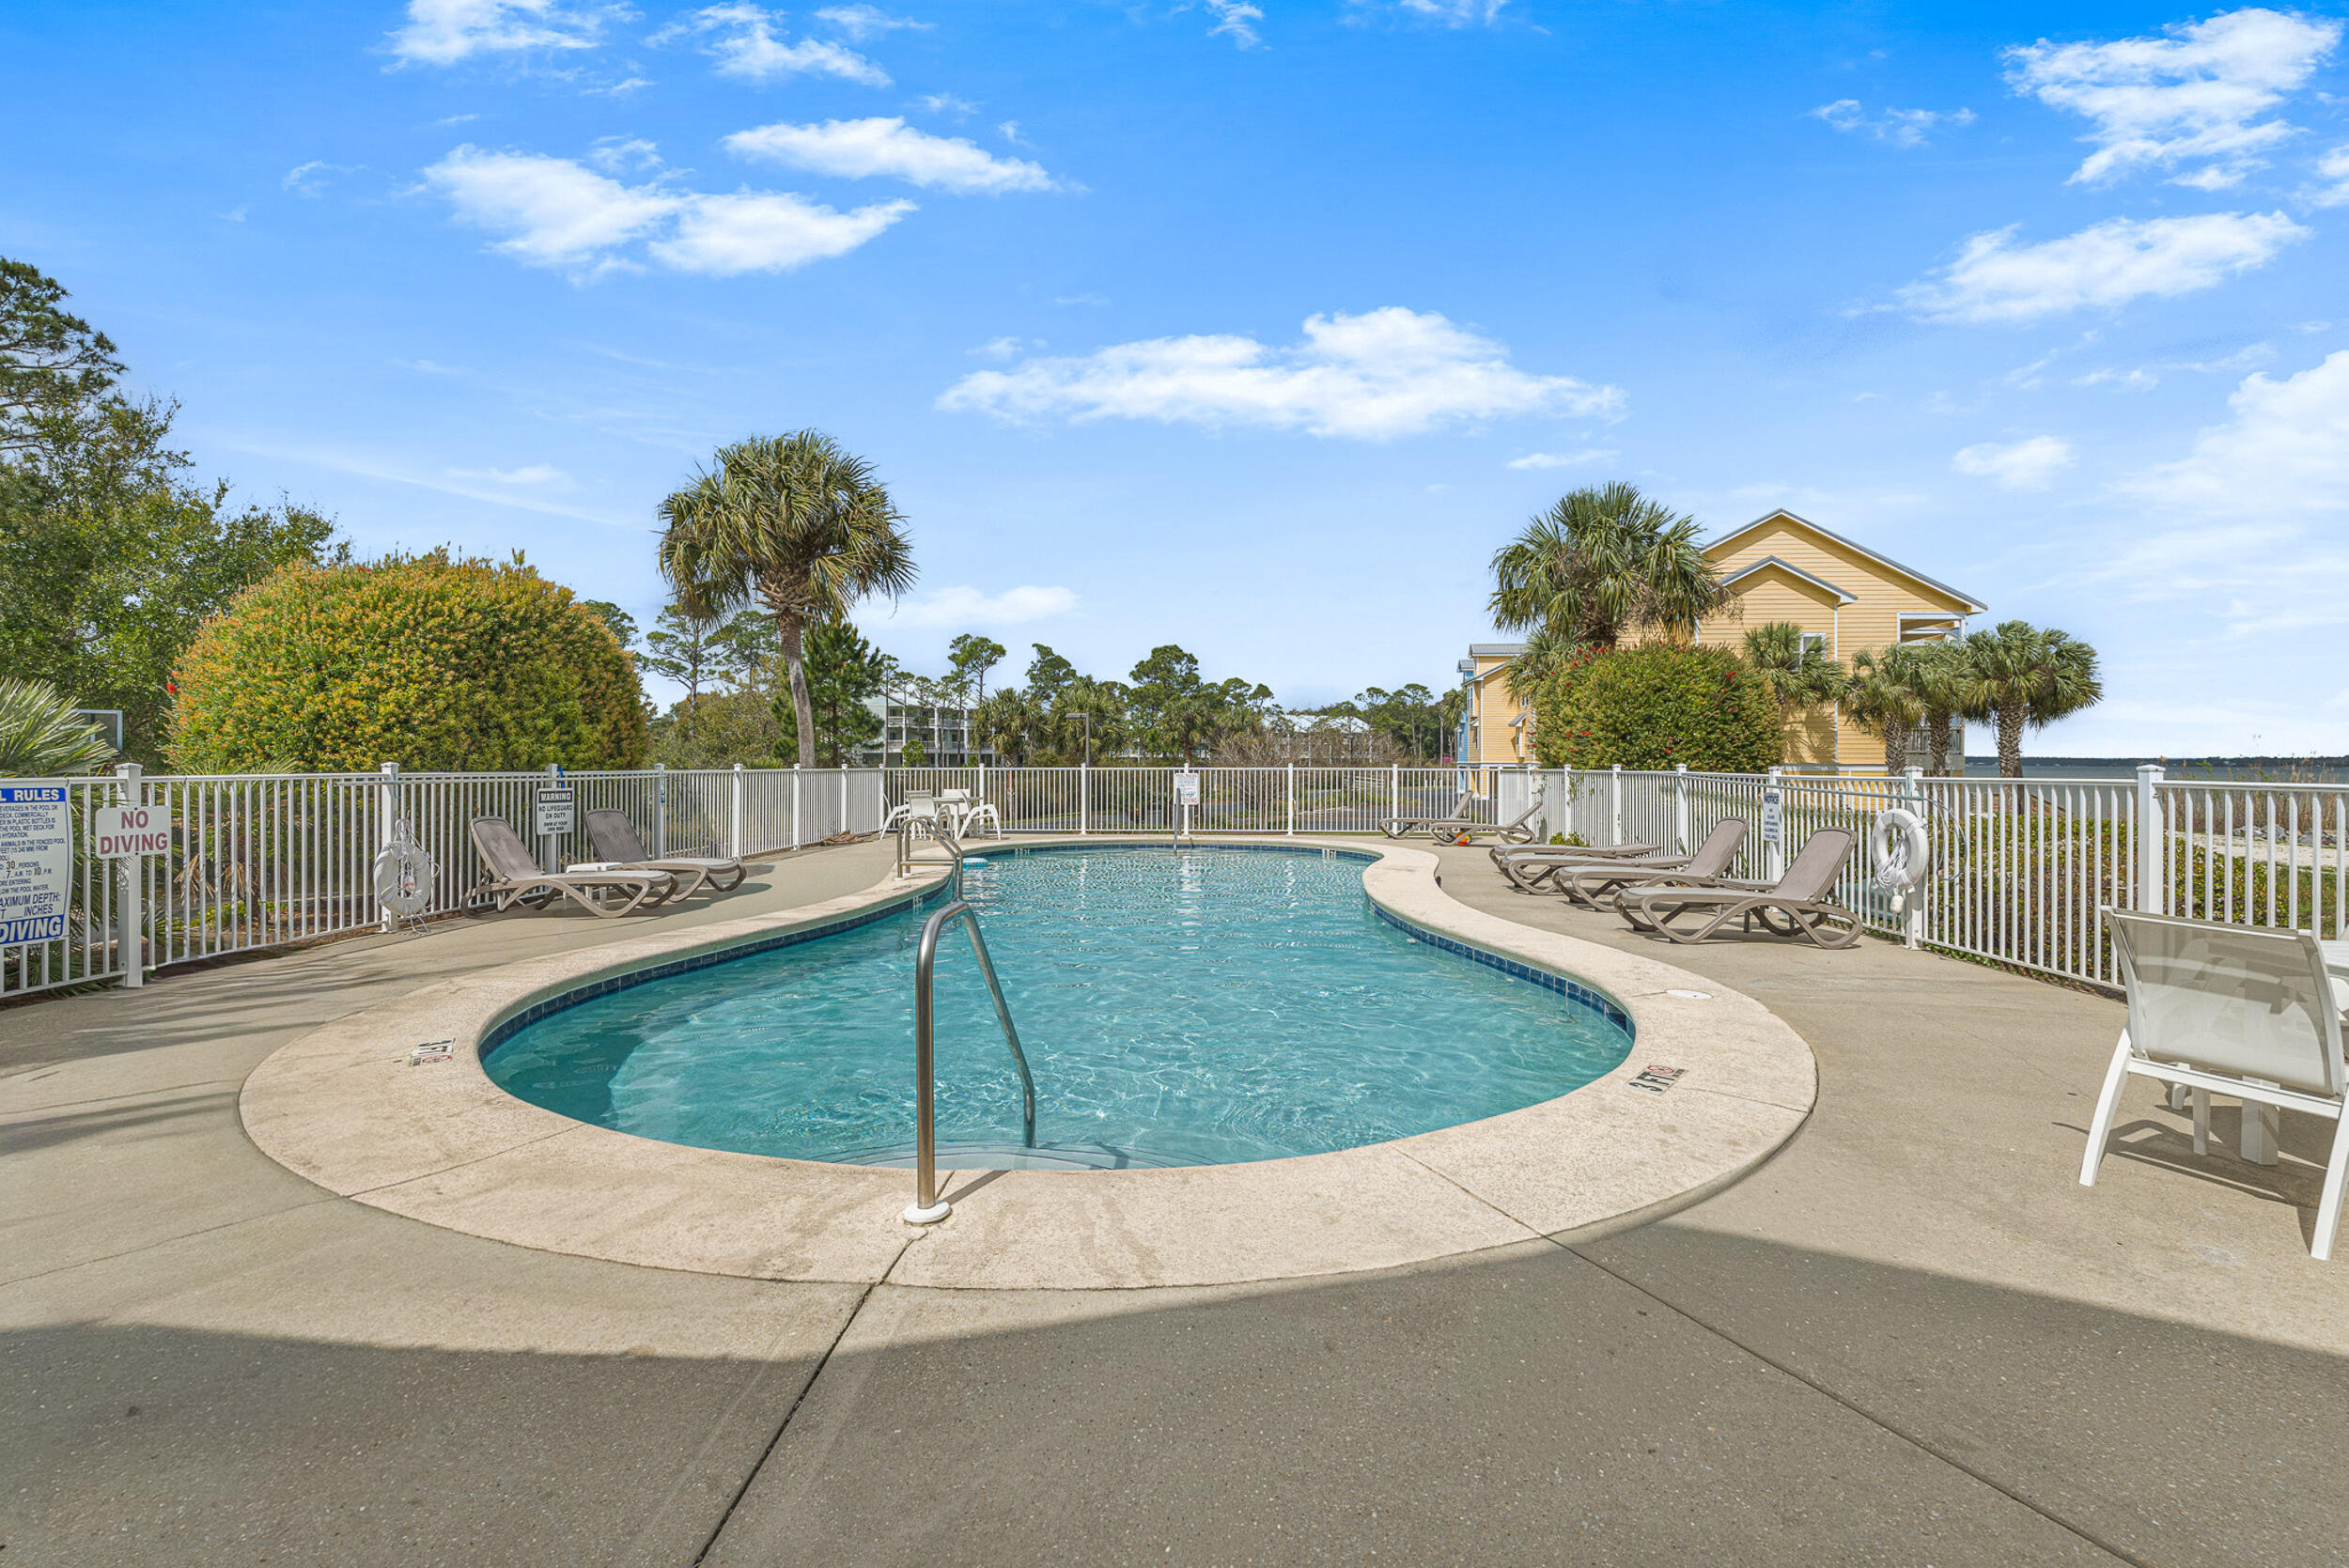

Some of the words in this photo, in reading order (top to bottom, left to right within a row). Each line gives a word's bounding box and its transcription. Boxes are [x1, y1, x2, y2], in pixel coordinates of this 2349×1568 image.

[14, 789, 59, 801] RULES
[541, 793, 571, 801] WARNING
[120, 811, 148, 829] NO
[101, 833, 167, 854] DIVING
[6, 861, 16, 870] 30
[33, 892, 61, 904] DEPTH:
[24, 904, 54, 917] INCHES
[0, 917, 62, 942] DIVING
